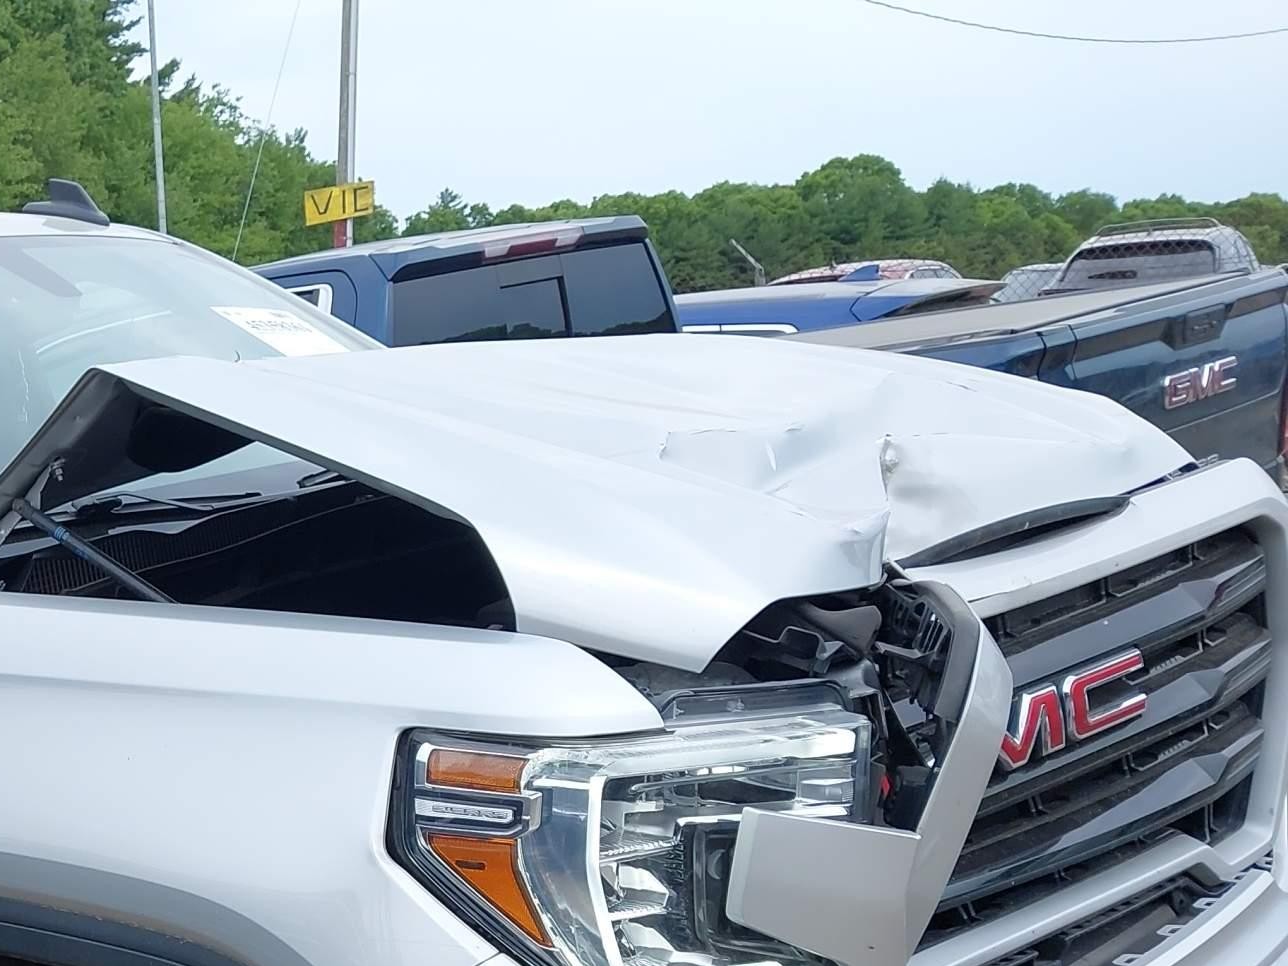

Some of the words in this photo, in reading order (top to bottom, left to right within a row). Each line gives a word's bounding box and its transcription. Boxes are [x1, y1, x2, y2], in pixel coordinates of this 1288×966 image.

[310, 186, 369, 216] VIC
[1164, 356, 1239, 410] GMC
[999, 648, 1148, 772] MC
